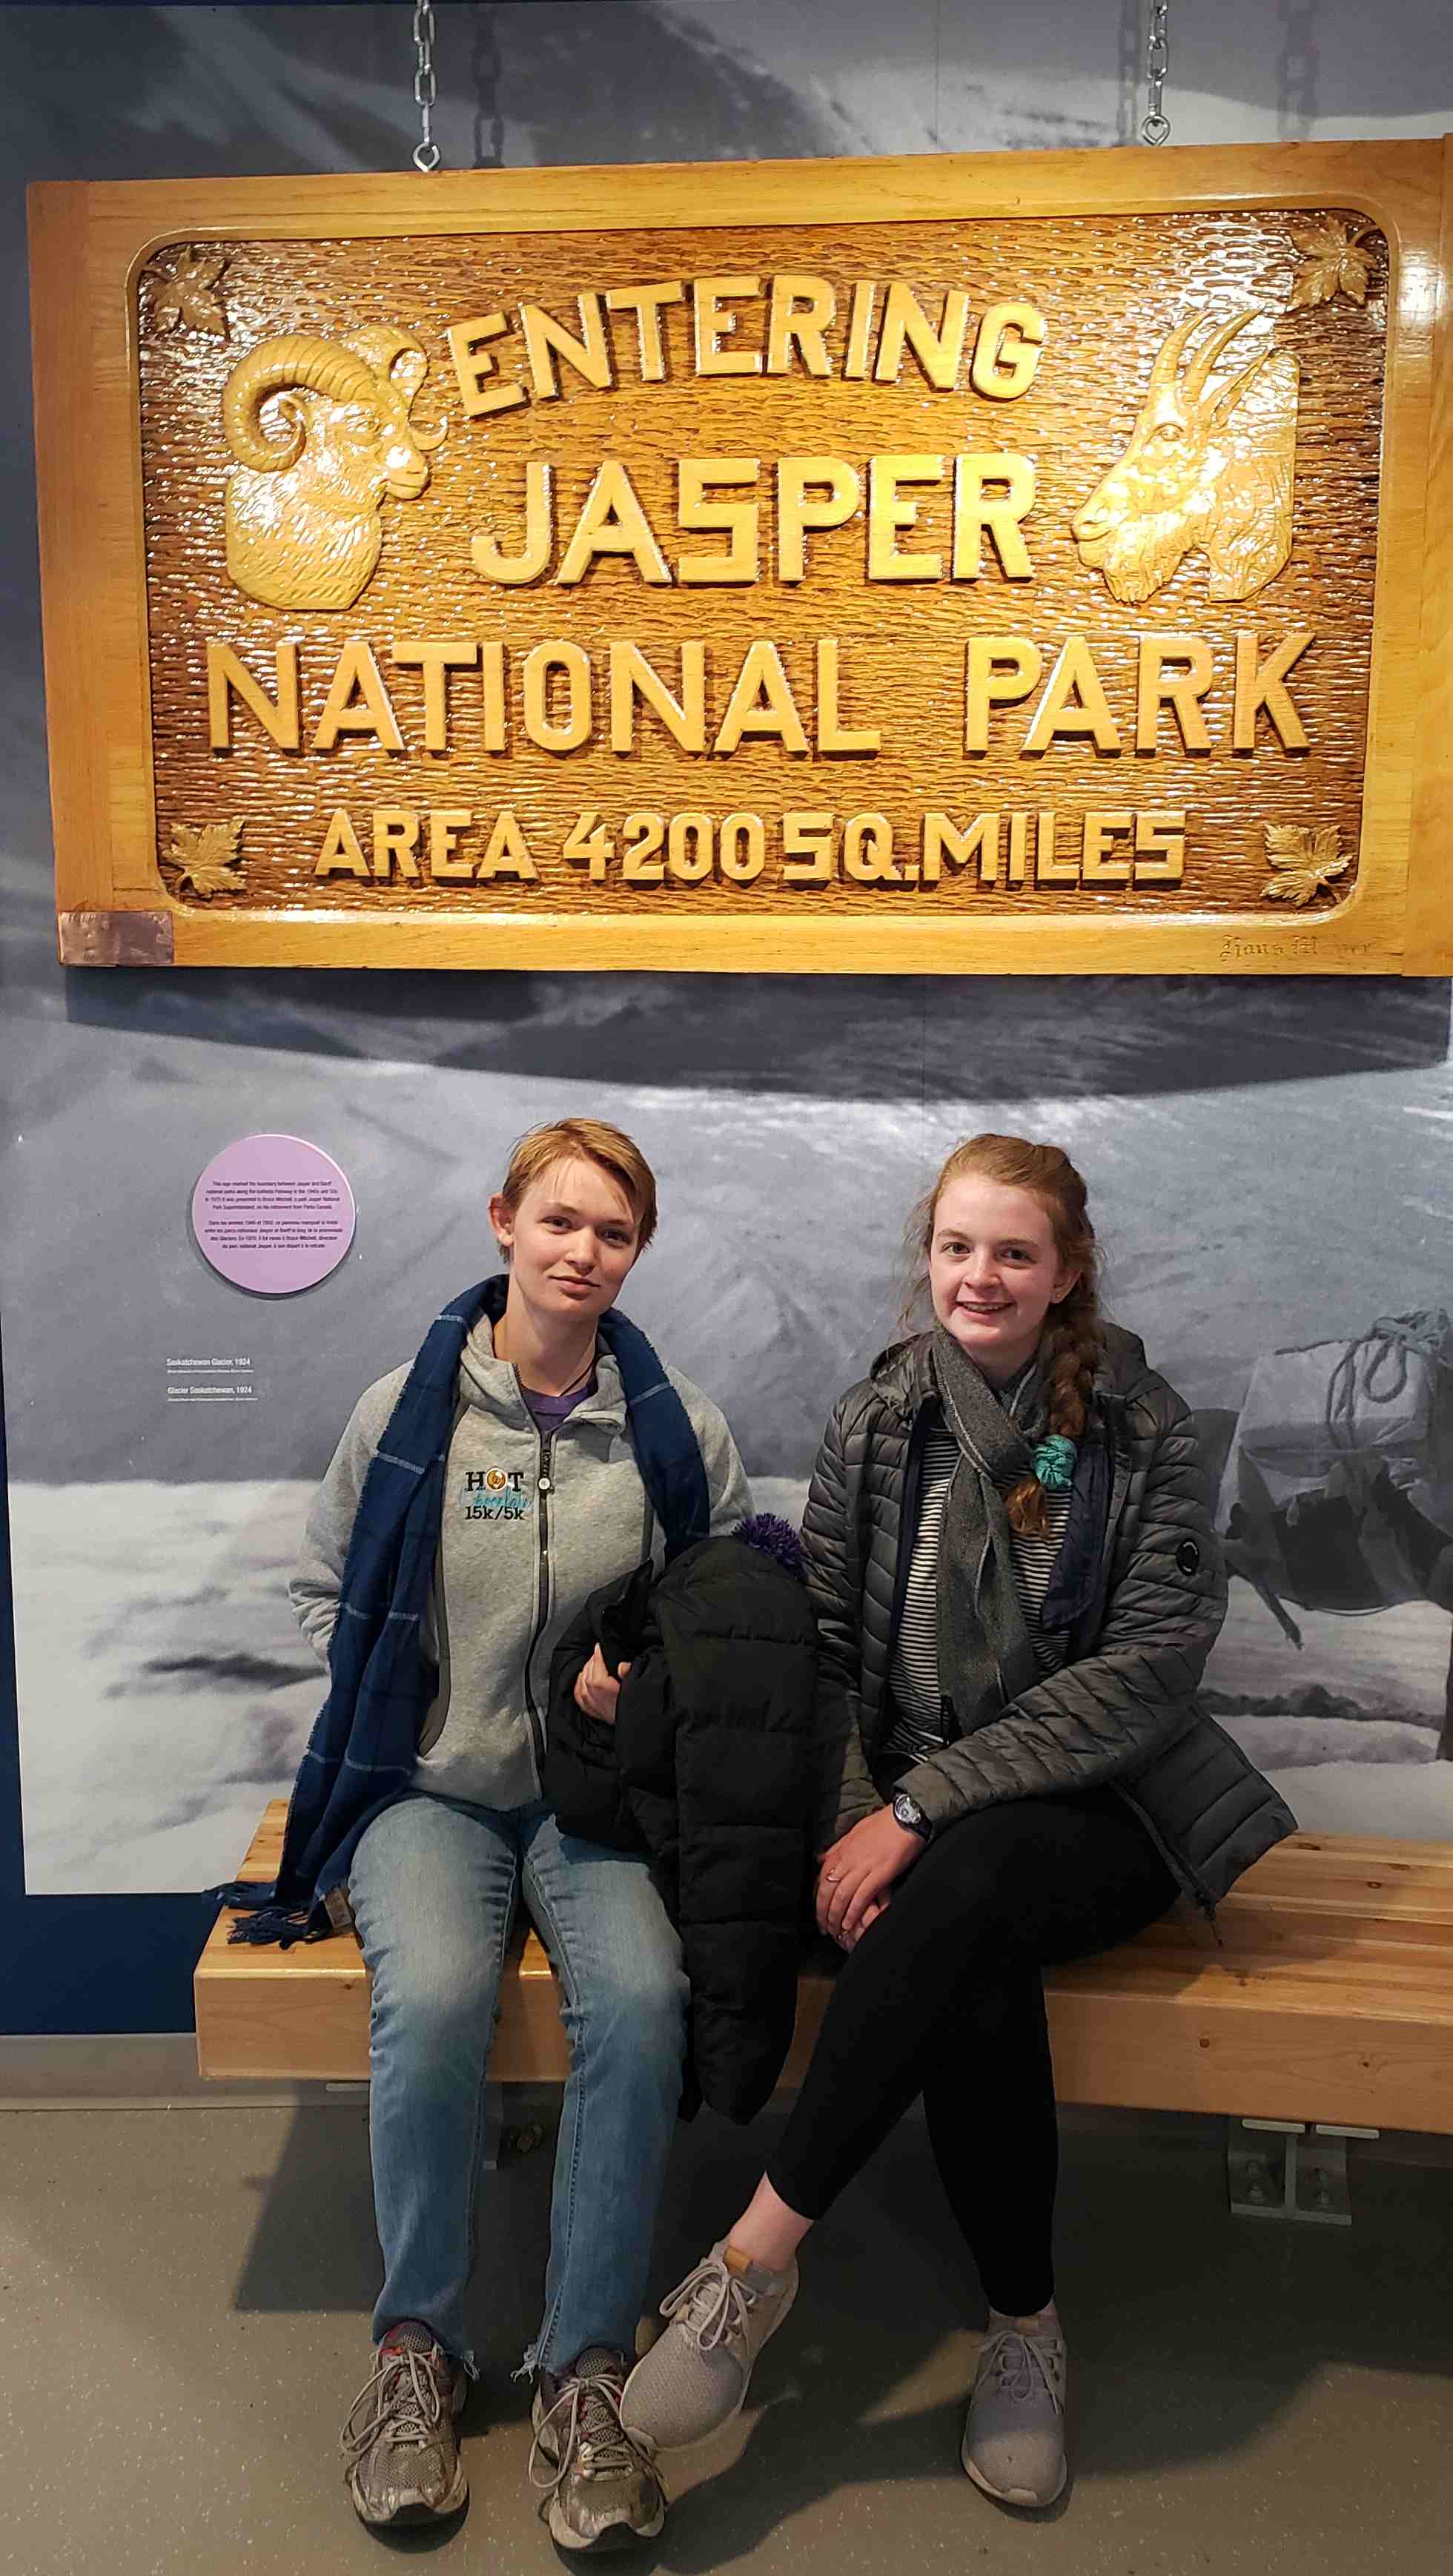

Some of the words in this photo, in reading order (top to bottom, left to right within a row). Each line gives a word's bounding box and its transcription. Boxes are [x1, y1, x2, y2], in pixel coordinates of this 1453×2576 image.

[446, 274, 1046, 420] ENTERING
[470, 452, 1037, 586] JASPER
[205, 638, 883, 758] NATIONAL
[962, 631, 1317, 758] PARK
[314, 808, 540, 882] AREA
[561, 810, 767, 884] 4200
[465, 1505, 525, 1520] 15k/5k
